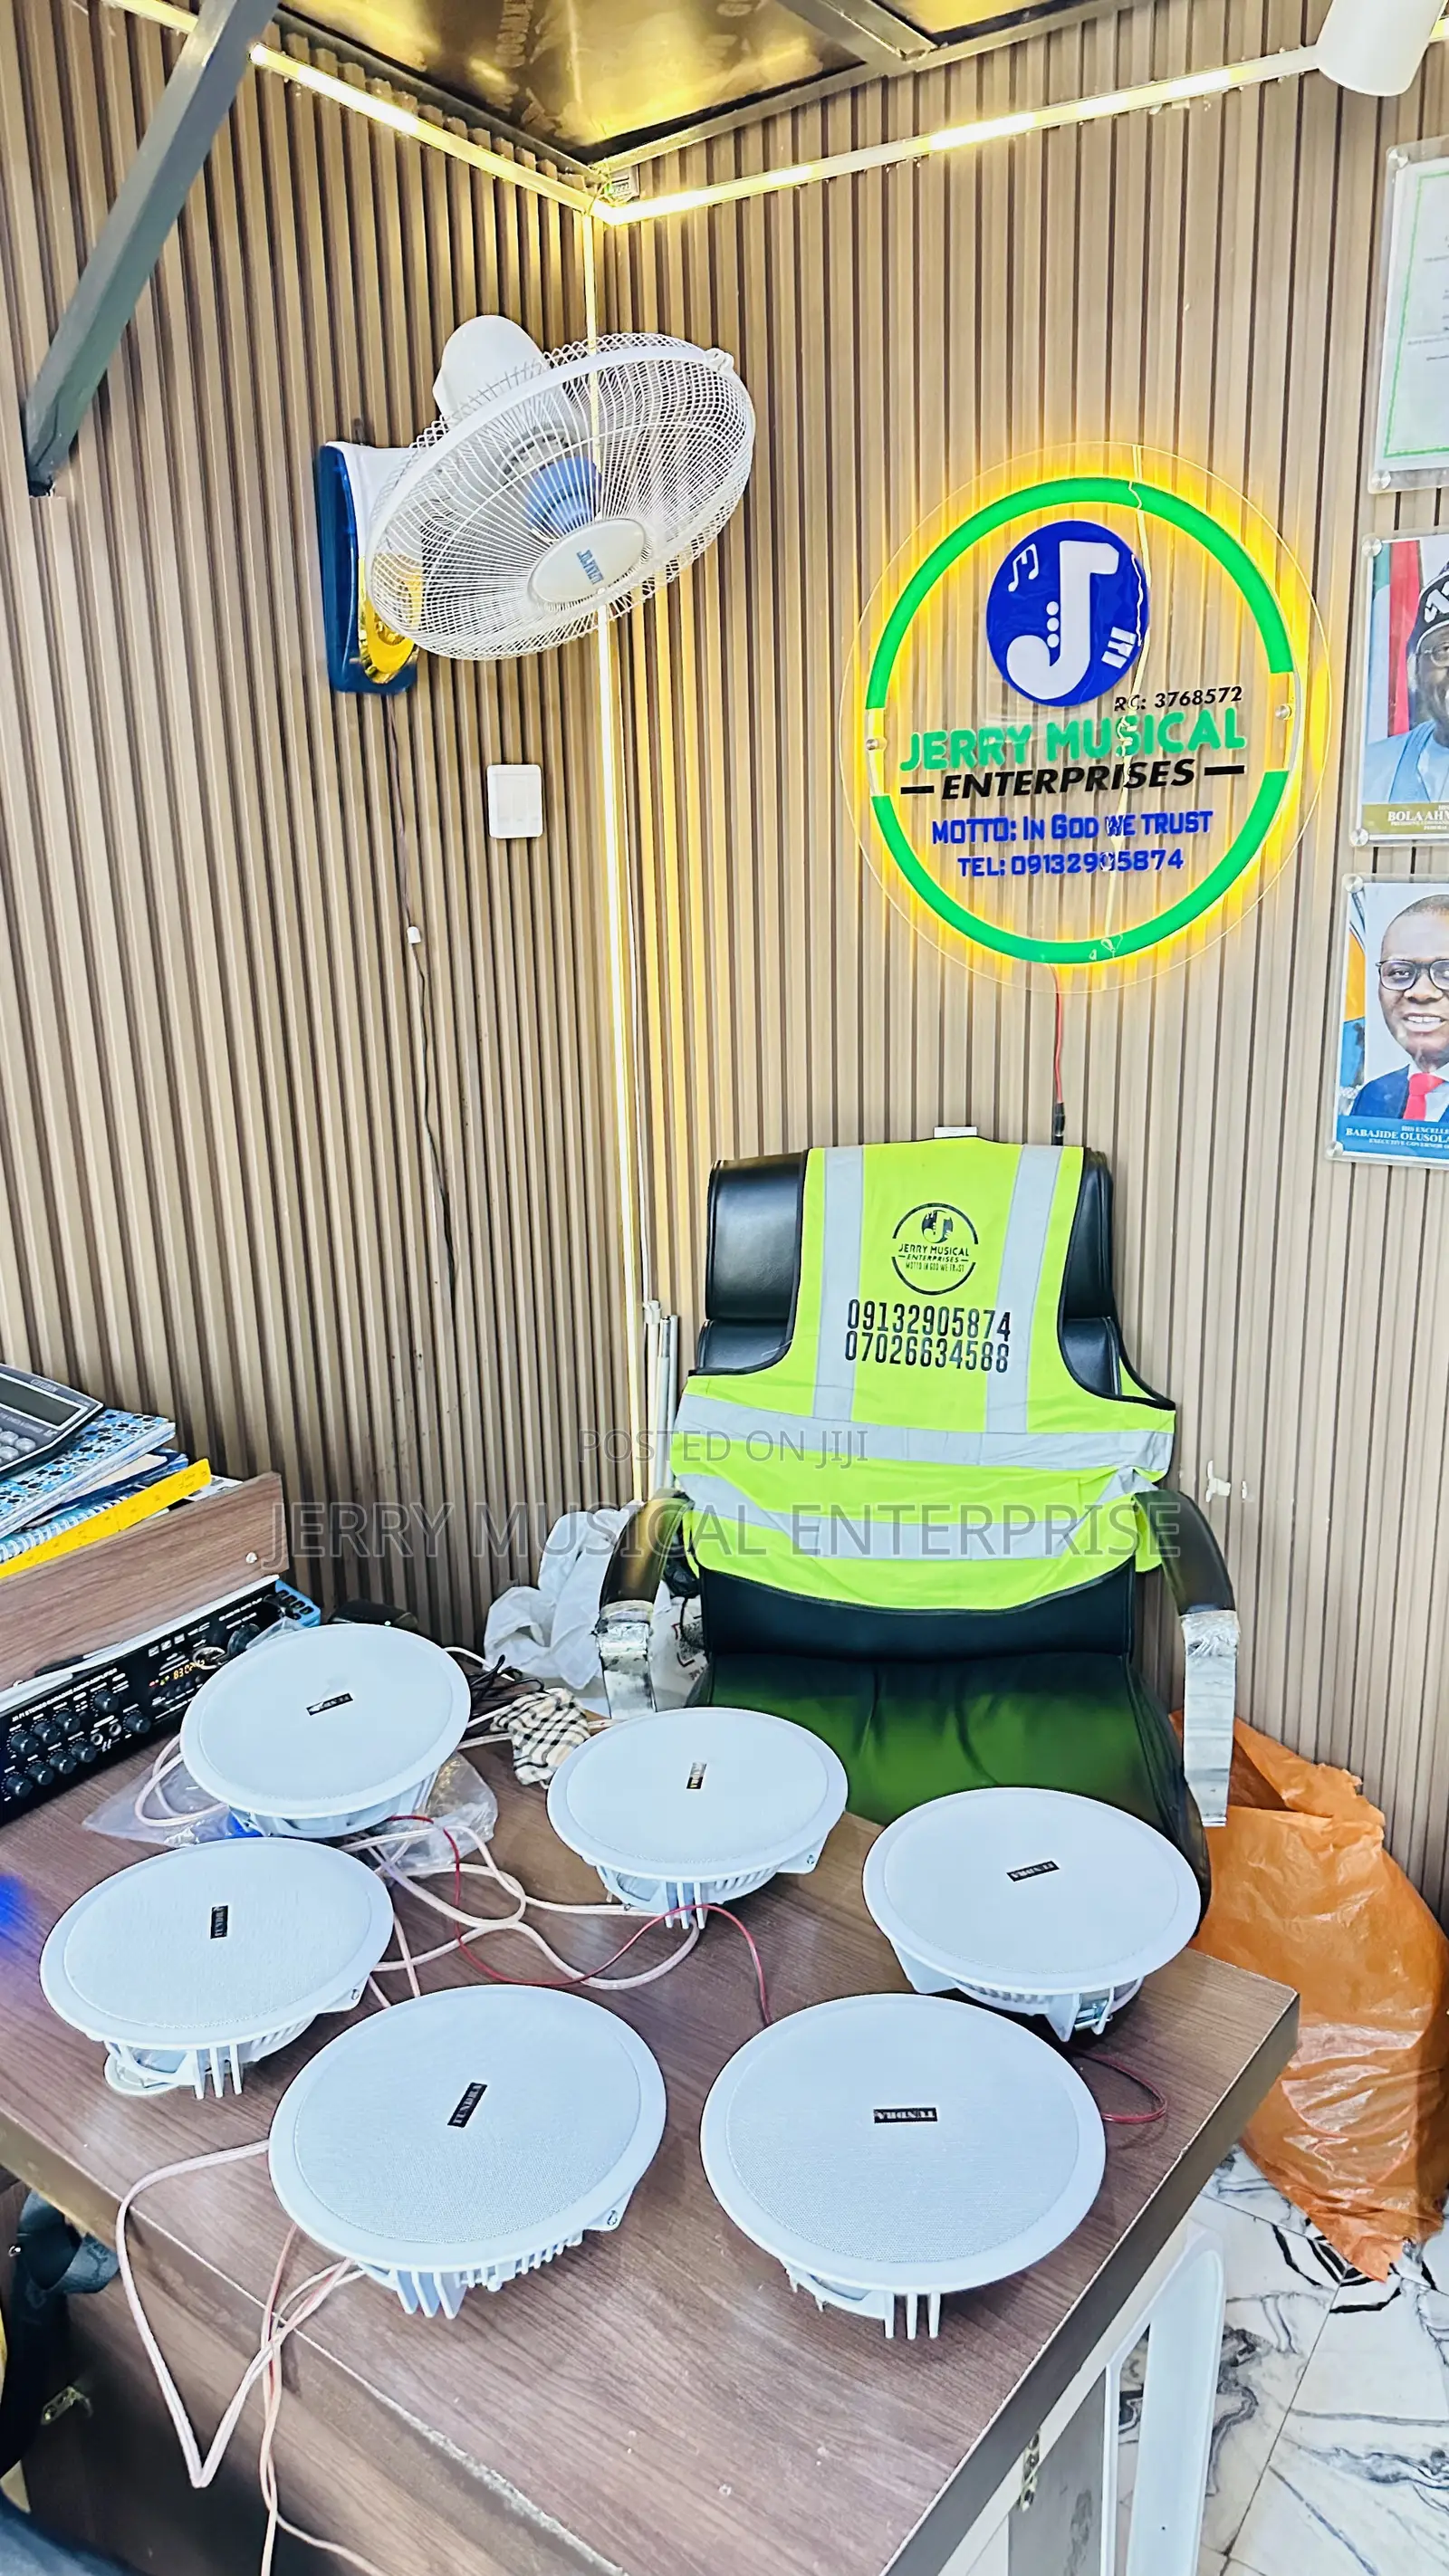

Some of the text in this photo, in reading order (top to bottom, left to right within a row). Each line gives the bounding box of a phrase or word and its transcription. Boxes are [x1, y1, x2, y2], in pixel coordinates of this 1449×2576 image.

[1154, 685, 1243, 708] 3768572
[899, 706, 1246, 771] JERRY MUSICAL
[942, 758, 1195, 800] ENTERPRISES
[932, 817, 1017, 844] MOTTO:
[1139, 810, 1214, 836] TRUST
[1387, 810, 1423, 821] BOLA
[957, 848, 1185, 877] TEL: 09132905874
[1346, 1127, 1398, 1140] BABAJIDE
[898, 1243, 969, 1257] JERRY MUSICAL
[907, 1253, 959, 1263] ENTERPRISES
[940, 1263, 948, 1272] WE
[847, 1298, 1012, 1342] 09132905874
[845, 1330, 1010, 1374] 07026634588
[453, 2084, 483, 2124] TUNDRA
[874, 2110, 936, 2120] TUNDRA
